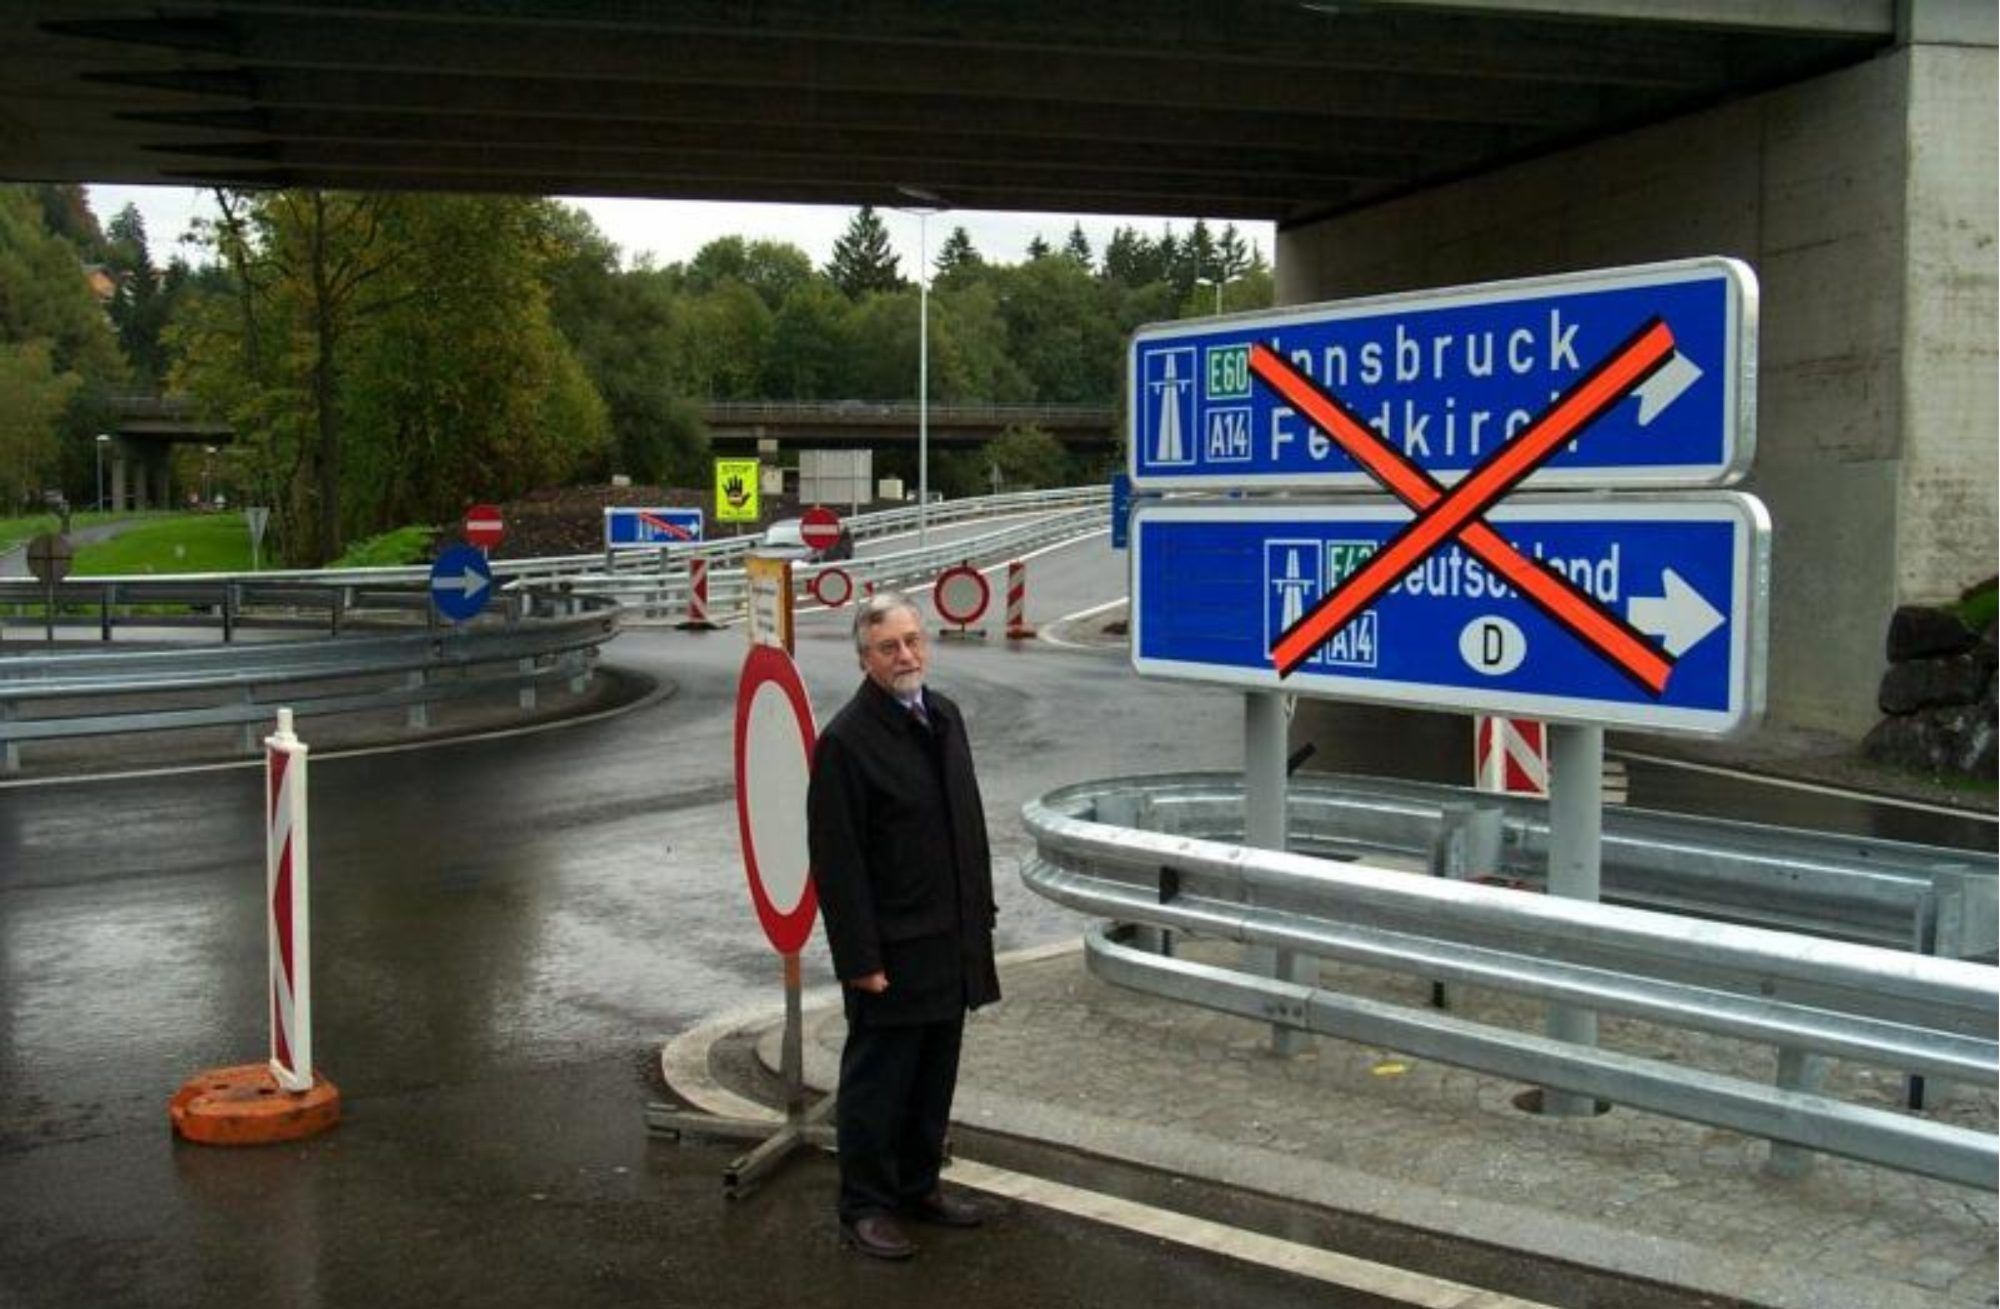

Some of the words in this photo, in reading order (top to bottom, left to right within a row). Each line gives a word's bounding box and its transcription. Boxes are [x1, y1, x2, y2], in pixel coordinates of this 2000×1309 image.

[1272, 308, 1580, 388] nnsbruck
[1210, 350, 1248, 394] E60
[1210, 412, 1248, 456] A14
[1270, 391, 1578, 461] Fedkirc
[1331, 616, 1372, 661] A14
[1483, 624, 1503, 665] D
